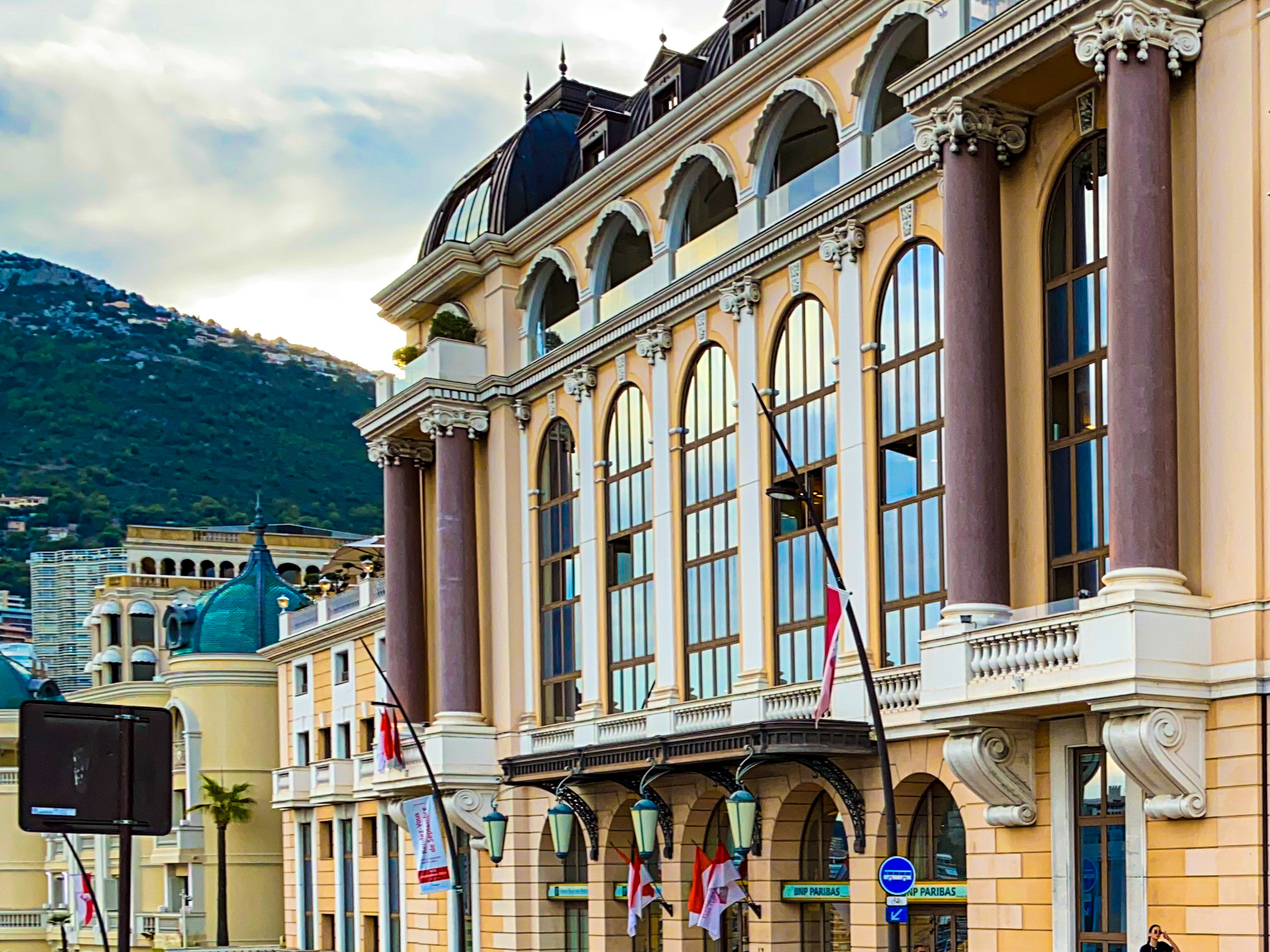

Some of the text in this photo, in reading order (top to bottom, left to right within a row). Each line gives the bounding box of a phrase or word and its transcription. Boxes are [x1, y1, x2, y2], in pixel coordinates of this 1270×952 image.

[794, 887, 840, 896] BNP PARIBAS
[906, 887, 957, 897] NP PARIBAS
